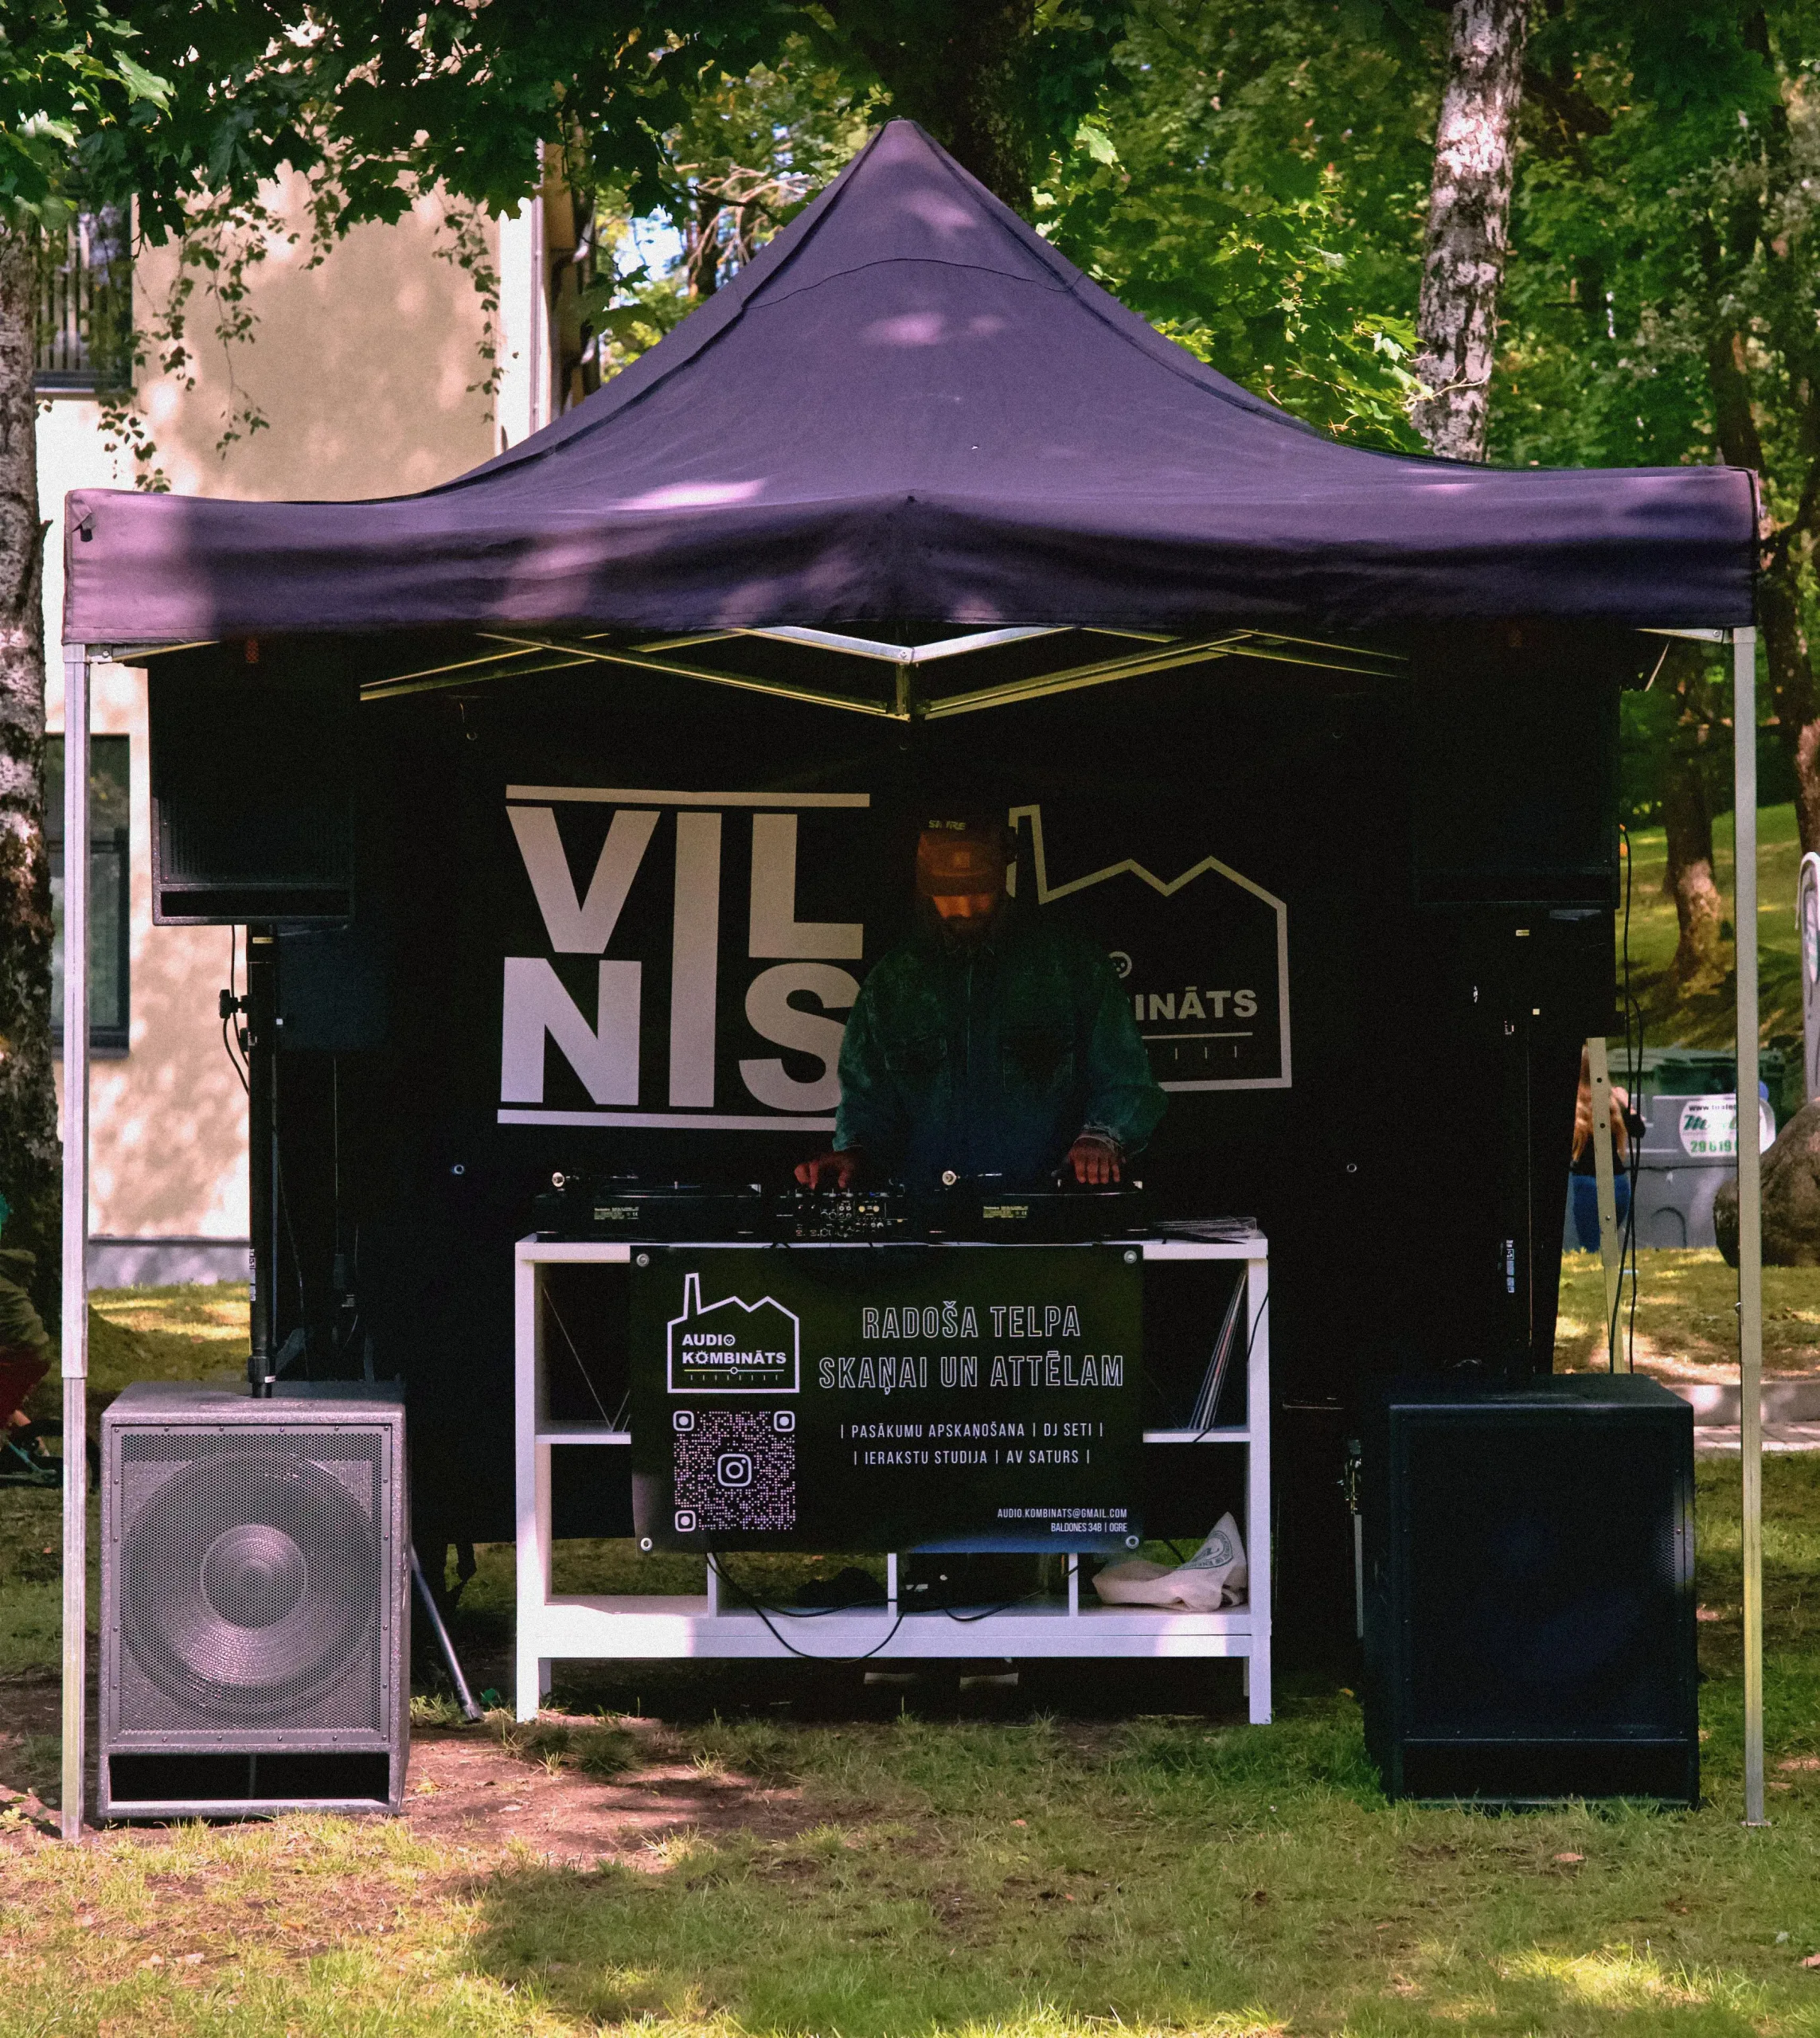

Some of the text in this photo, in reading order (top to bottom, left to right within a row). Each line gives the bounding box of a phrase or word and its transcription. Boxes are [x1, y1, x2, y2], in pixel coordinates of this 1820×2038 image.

[1135, 986, 1258, 1021] INĀTS
[862, 1300, 1080, 1339] RADOŠA TELPA
[682, 1333, 736, 1347] AUDIO
[682, 1349, 787, 1365] KOMBINĀTS
[818, 1350, 1123, 1396] SKAŅAI UN ATTĒLAM
[851, 1420, 1092, 1439] PASĀKUMU APSKAŅOŠANA DJ SETI
[865, 1450, 1080, 1465] IERAKSTU STUDIJA AV SATURS
[997, 1508, 1128, 1519] AUDIO.KOMBINATS@GMAIL.COM
[1051, 1522, 1127, 1533] BALDONES 34B OGRE
